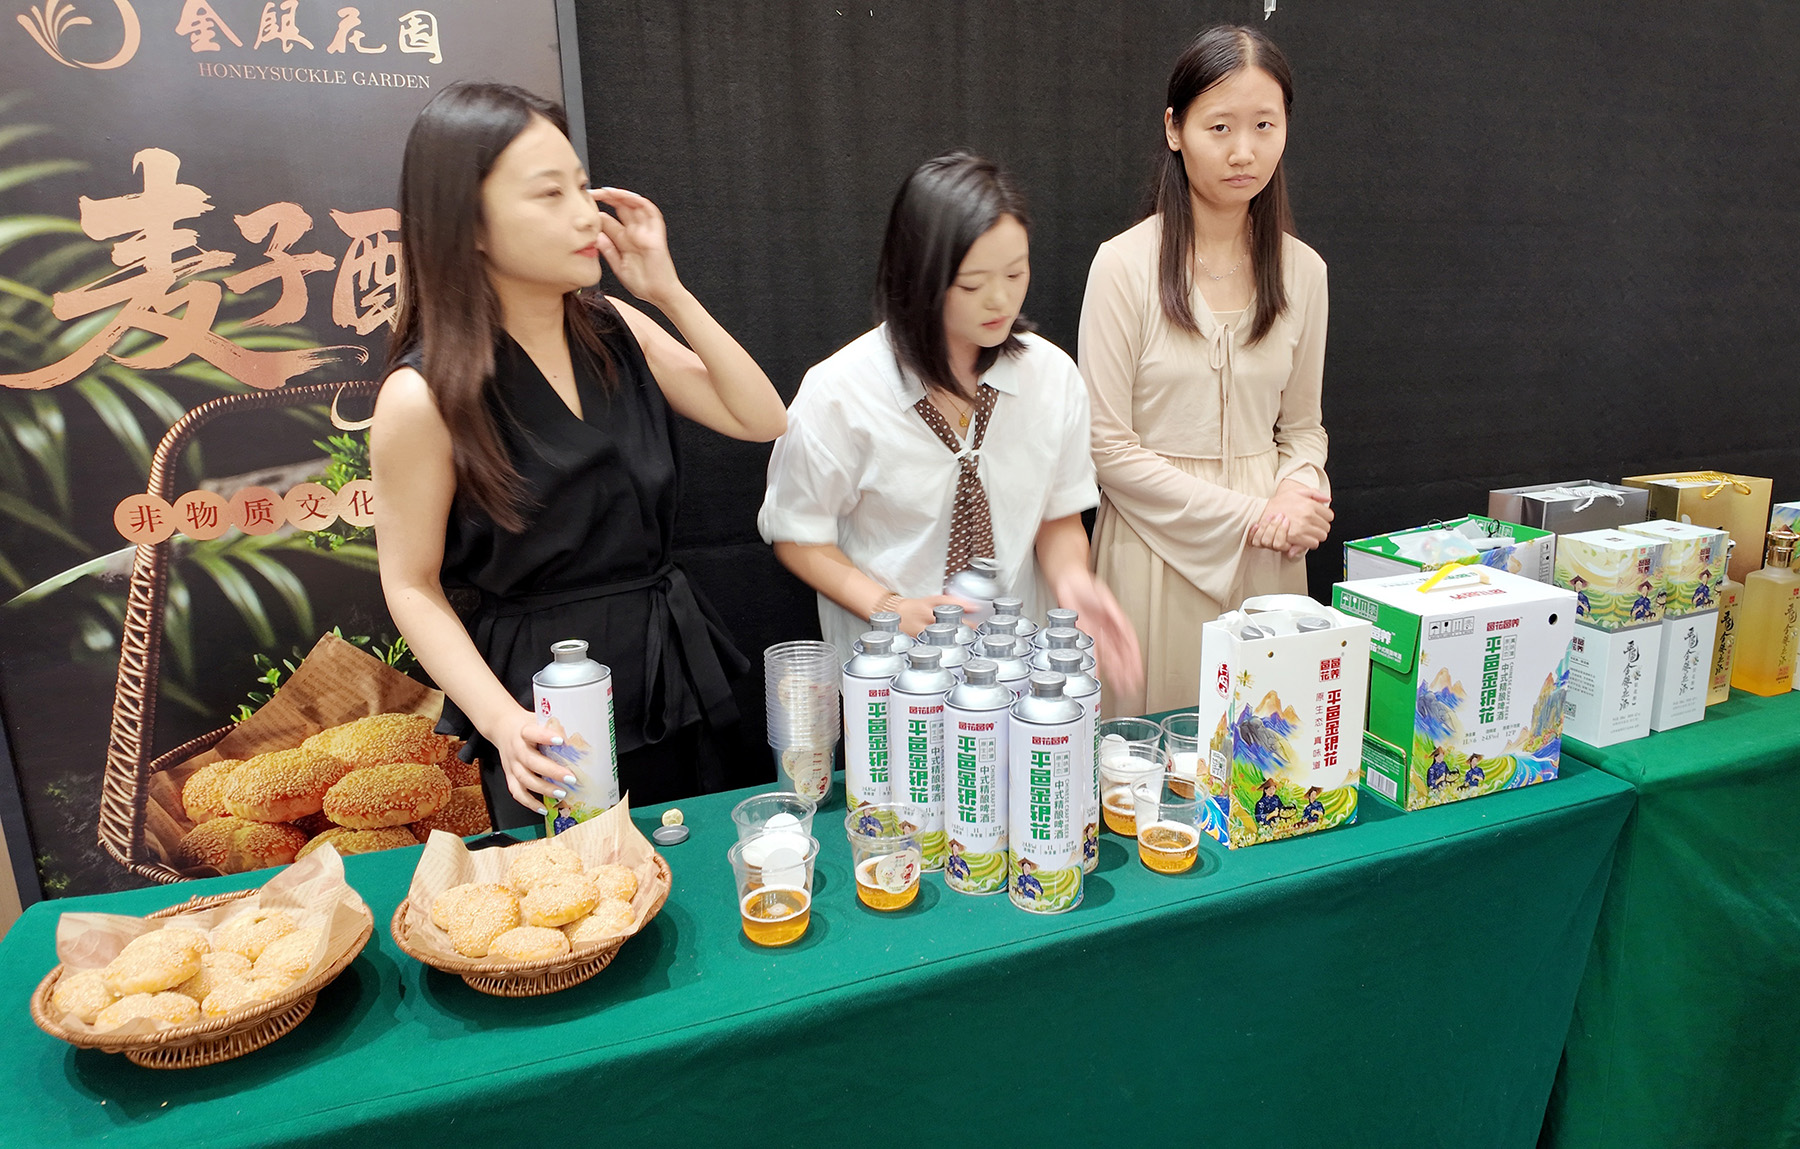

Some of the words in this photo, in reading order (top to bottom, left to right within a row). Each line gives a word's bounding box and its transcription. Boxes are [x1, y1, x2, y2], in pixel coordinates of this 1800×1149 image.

[198, 62, 347, 85] HONEYSUCKLE
[352, 71, 431, 88] GARDEN
[129, 490, 374, 533] 非物质文化
[1479, 635, 1502, 725] 平邑金银花
[868, 702, 888, 783] 平邑金银花
[908, 719, 929, 803] 平邑金银花
[1323, 689, 1342, 767] 平邑金银花
[957, 735, 976, 823] 平邑金银花
[1030, 750, 1051, 840] 平邑金银花
